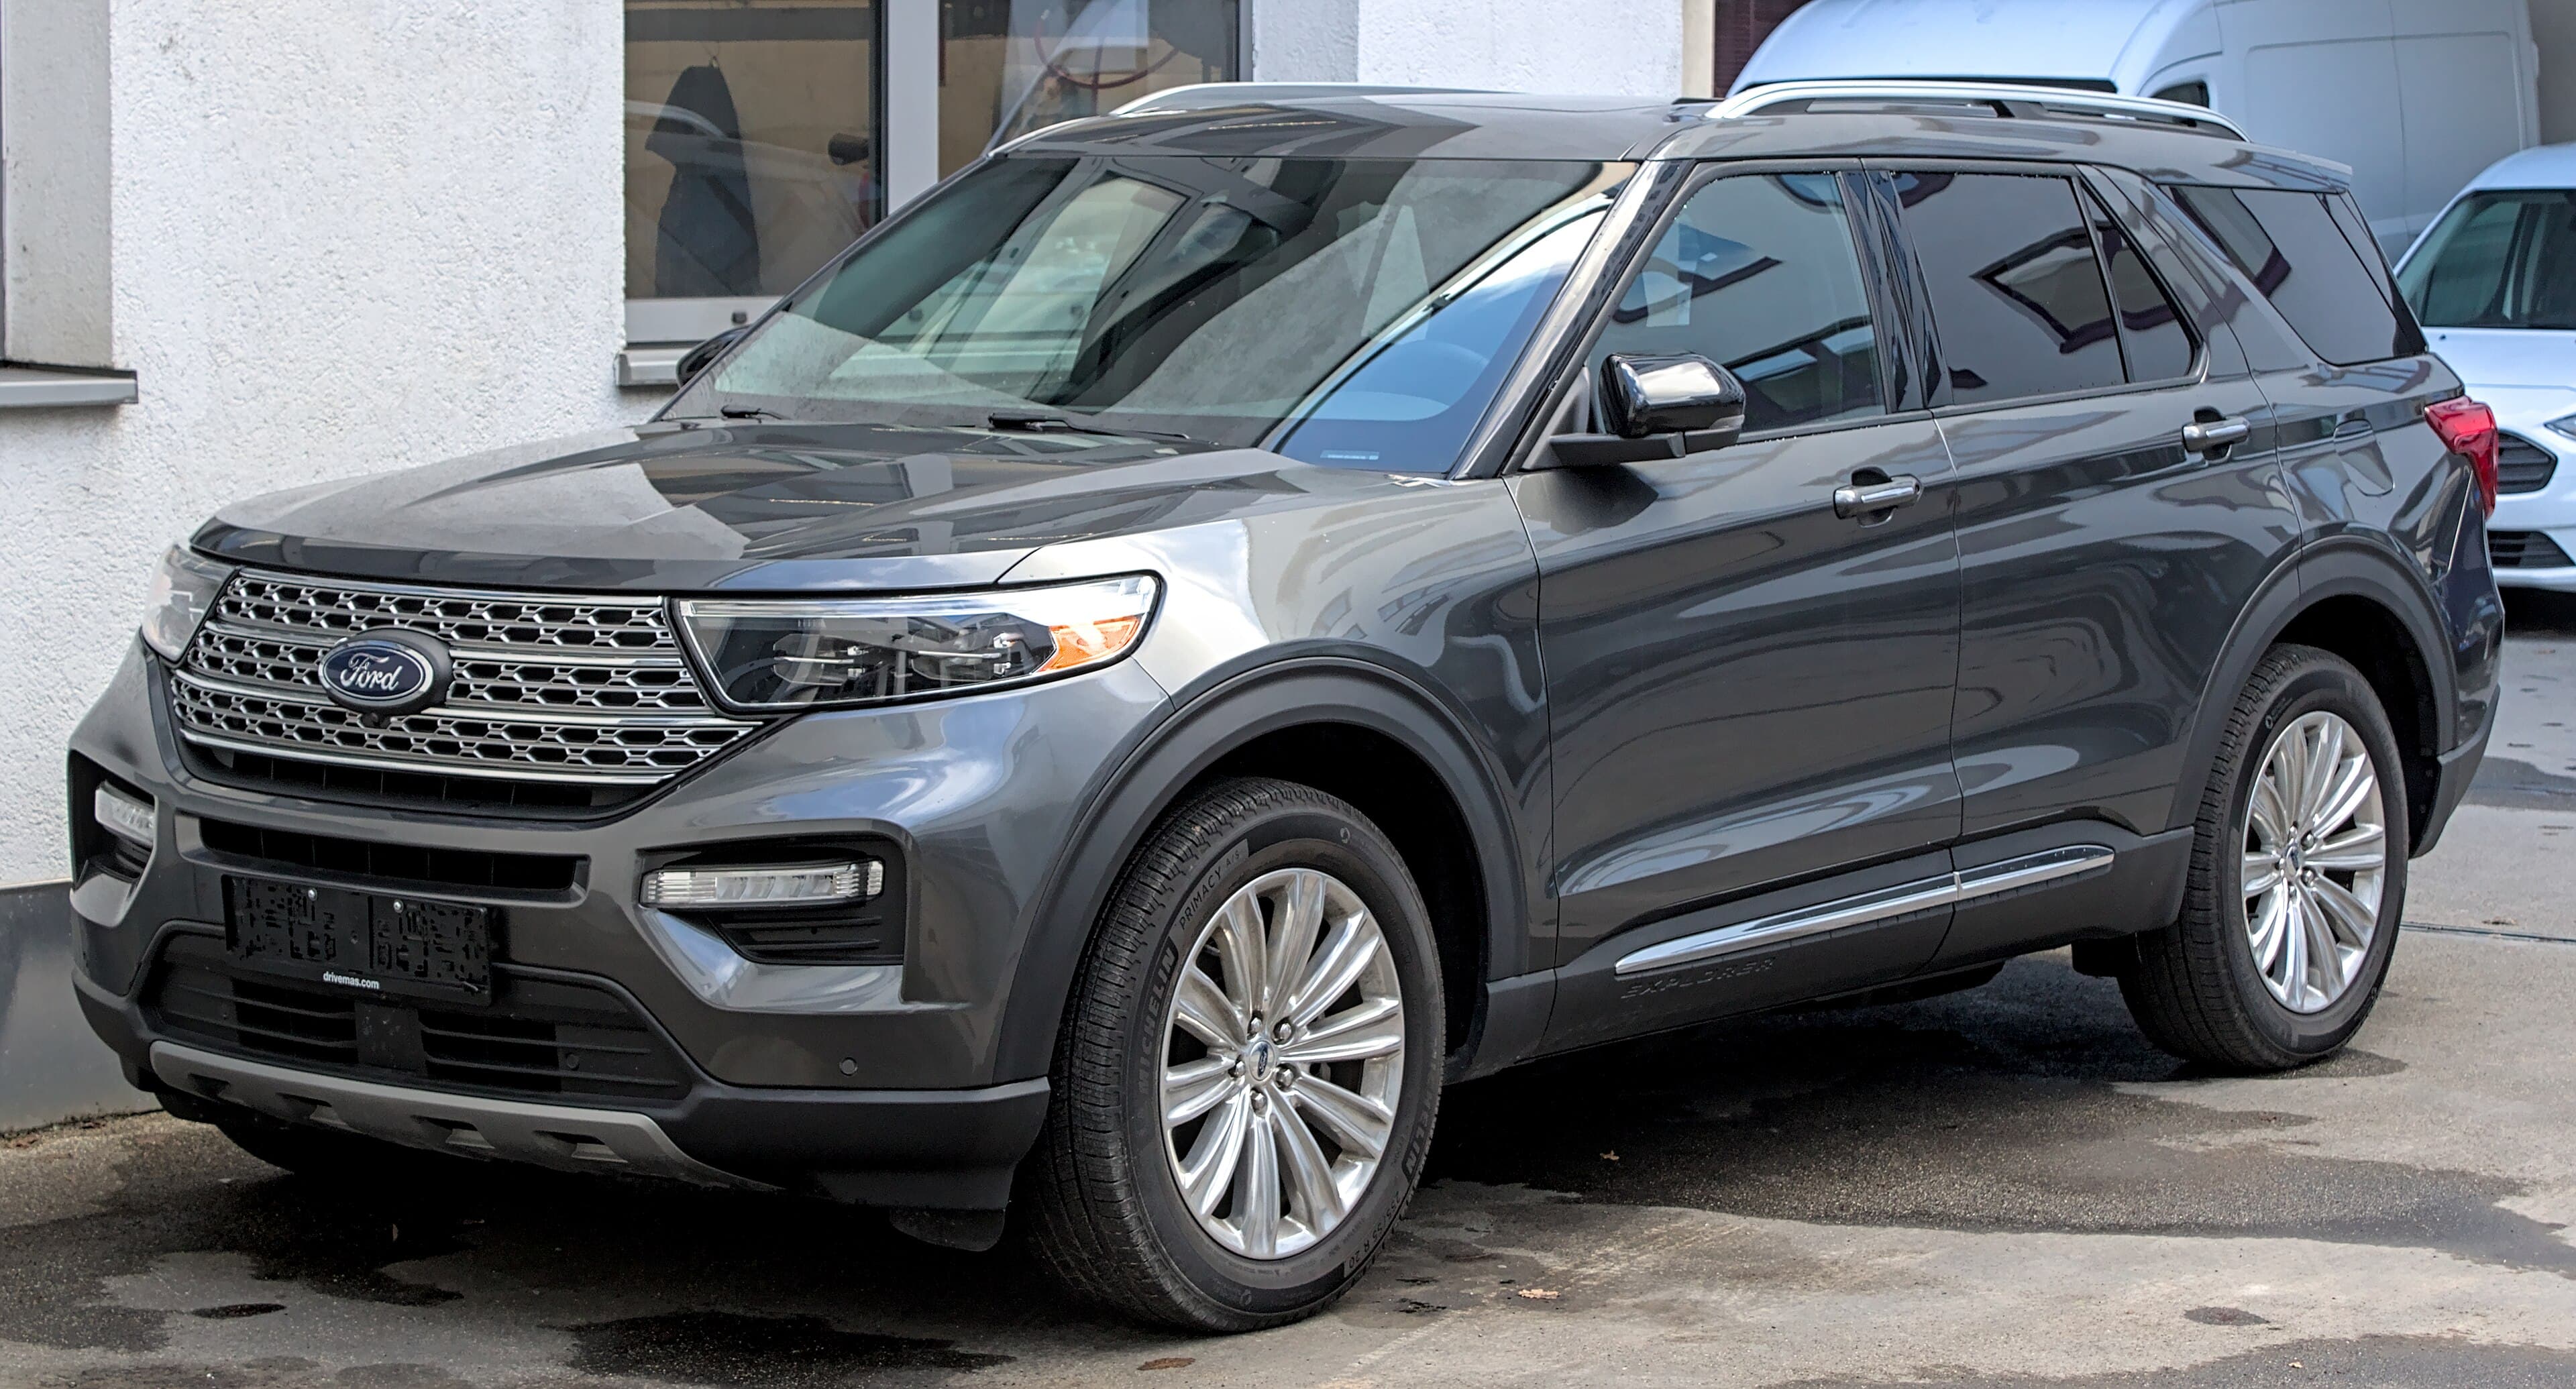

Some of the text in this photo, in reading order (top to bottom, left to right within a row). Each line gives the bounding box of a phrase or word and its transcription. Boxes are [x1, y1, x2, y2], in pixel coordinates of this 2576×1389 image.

[339, 652, 404, 691] Ford
[1179, 866, 1222, 930] PRIMACY
[323, 971, 380, 989] drivemas.com
